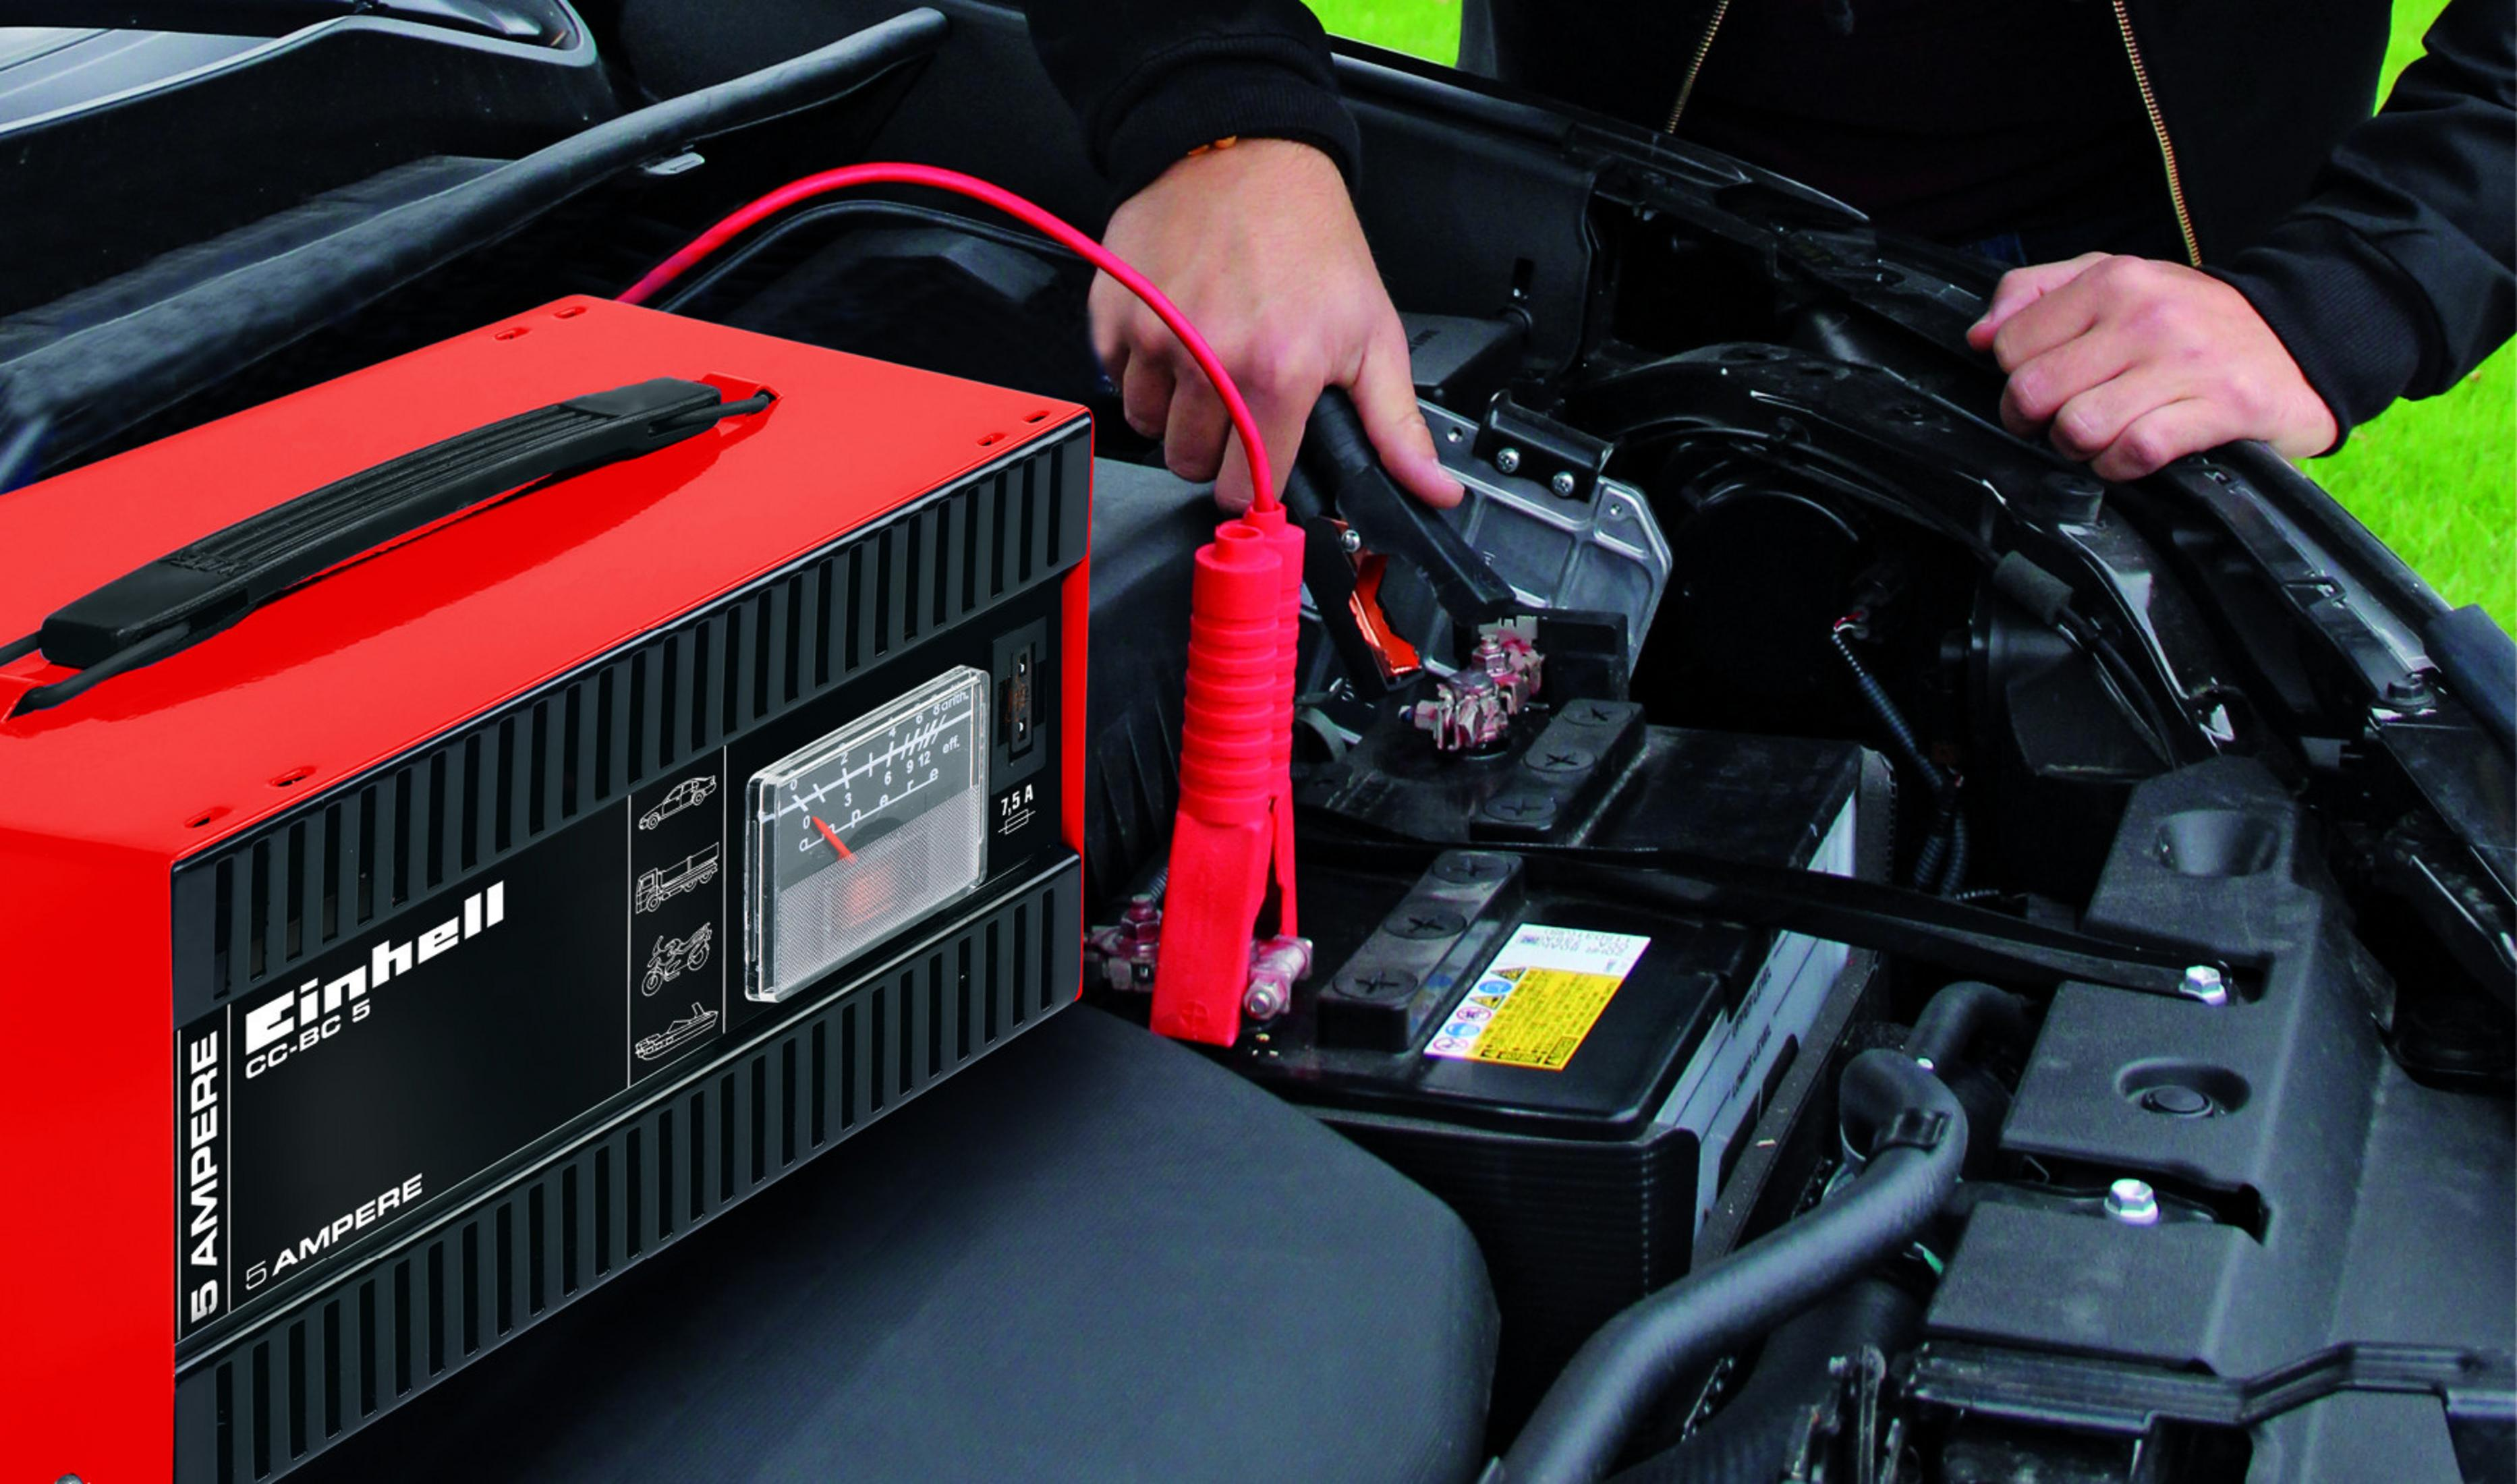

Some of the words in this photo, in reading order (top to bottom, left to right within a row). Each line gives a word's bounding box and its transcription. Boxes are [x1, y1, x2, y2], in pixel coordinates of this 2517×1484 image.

[843, 793, 853, 807] 3
[884, 770, 893, 786] 6
[905, 759, 915, 774] 9
[917, 750, 931, 768] 12
[1024, 783, 1034, 804] A
[246, 880, 504, 1056] Einhell
[245, 1014, 341, 1079] CC-BC
[351, 998, 371, 1023] 5
[190, 1031, 219, 1266] AMPERE
[245, 1260, 267, 1291] 5
[271, 1173, 424, 1277] AMPERE
[190, 1279, 219, 1325] 5
